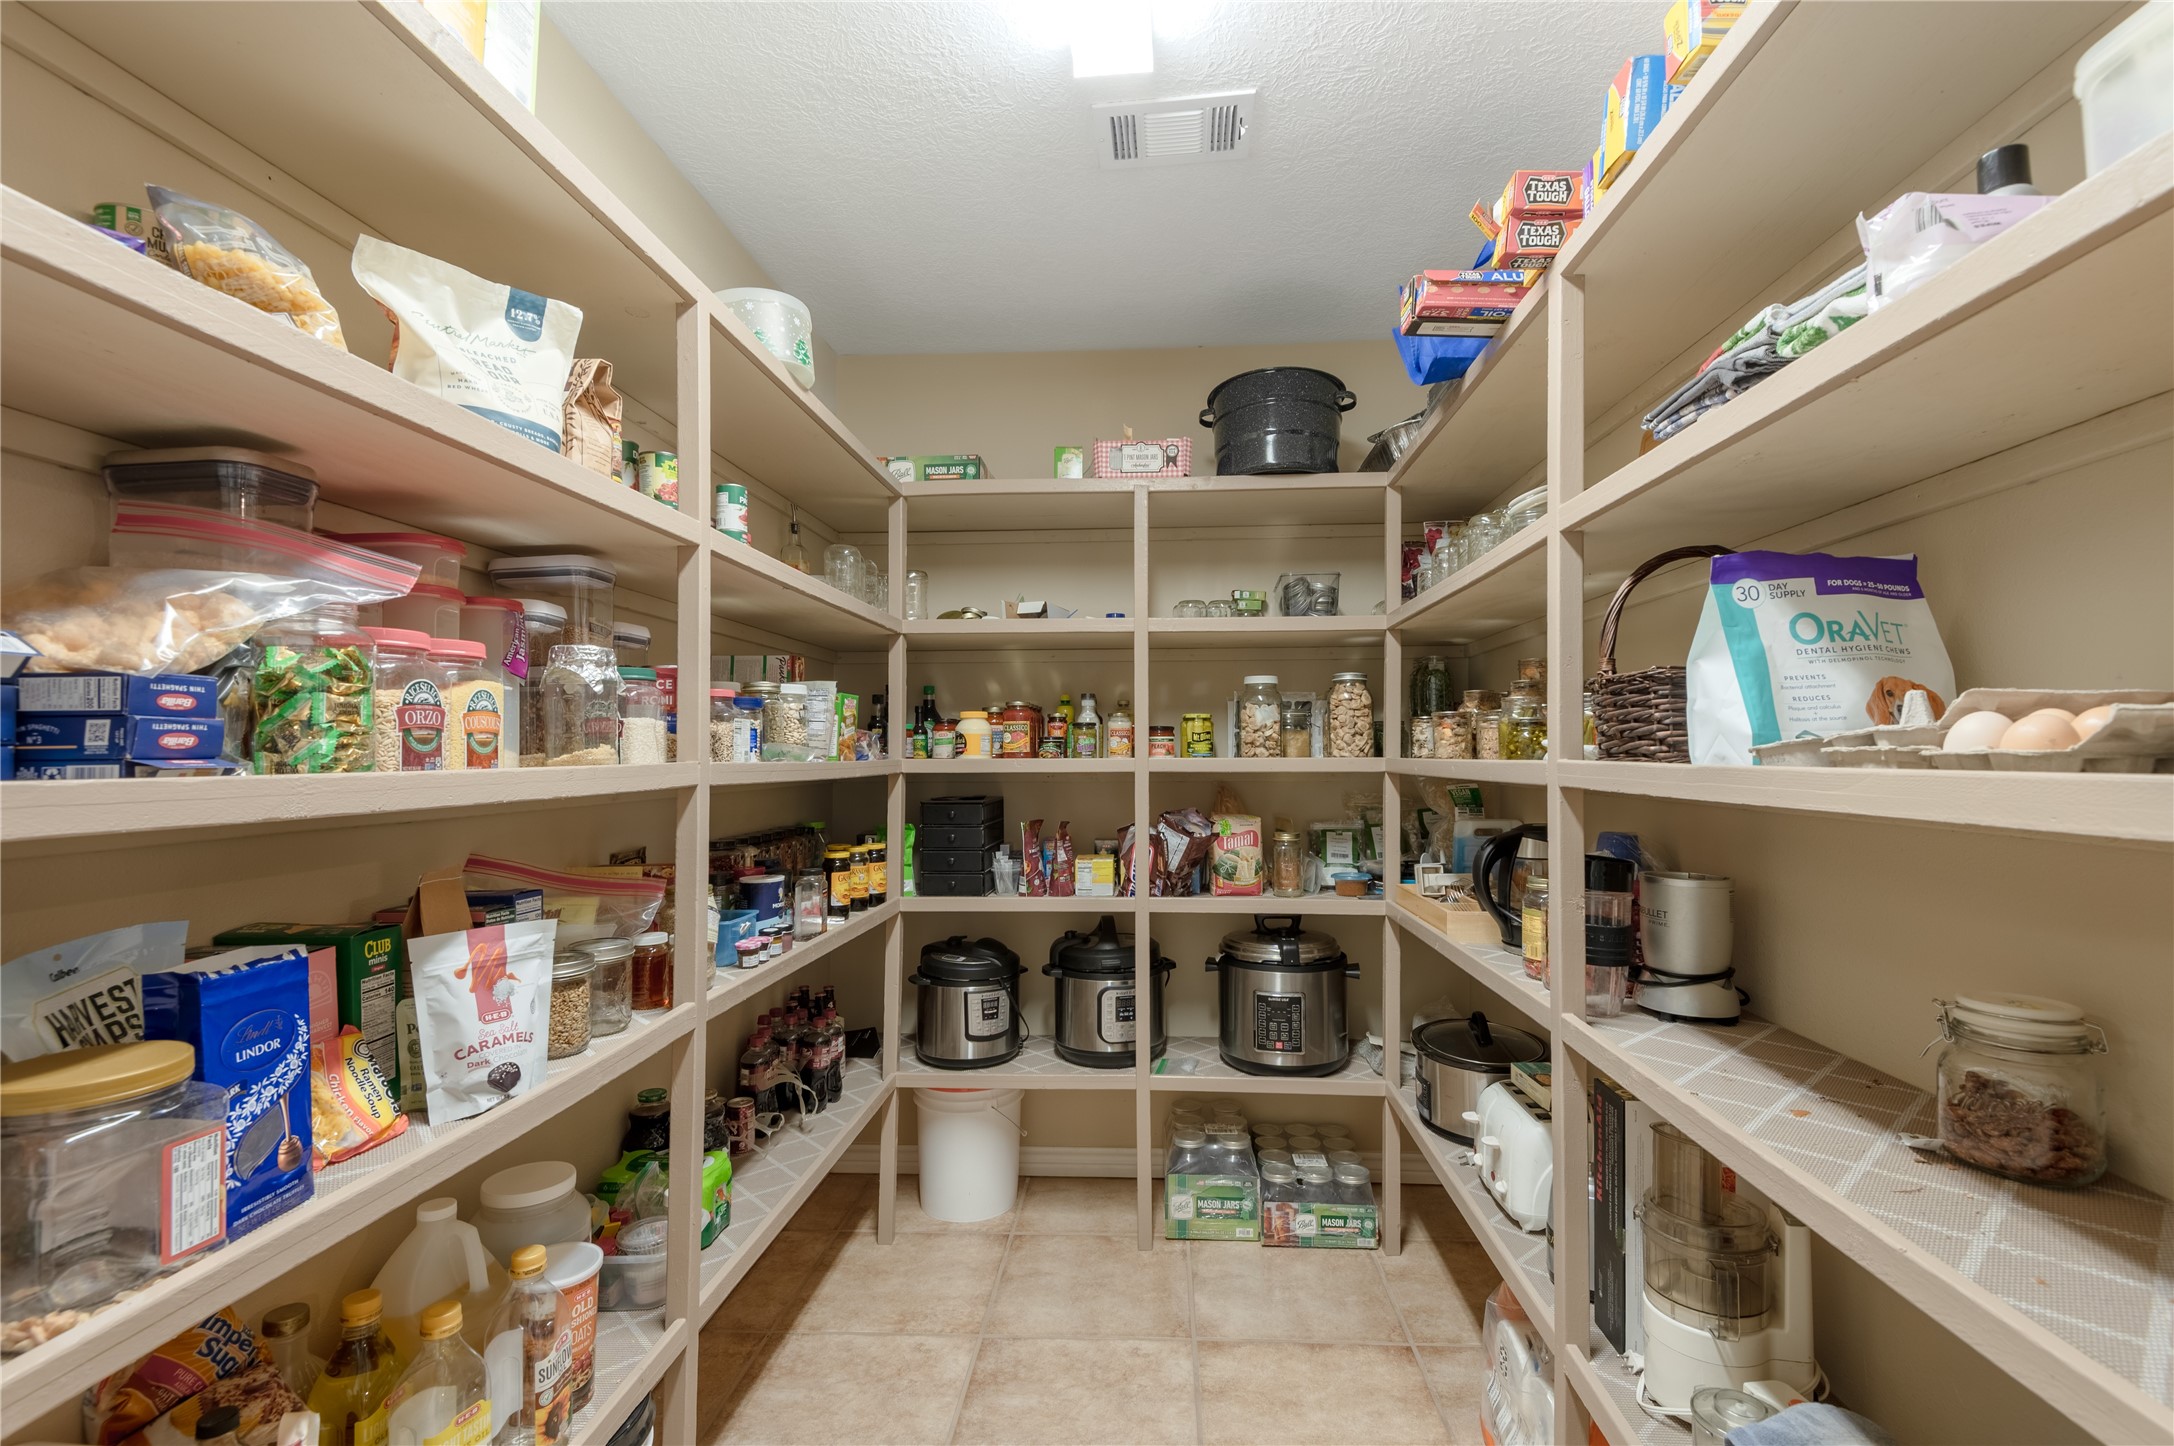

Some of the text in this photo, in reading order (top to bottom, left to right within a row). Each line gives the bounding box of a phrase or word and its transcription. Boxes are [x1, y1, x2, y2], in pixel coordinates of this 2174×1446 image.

[1529, 181, 1567, 192] TEXAS
[1527, 191, 1568, 202] TOUGH
[1522, 225, 1559, 236] TEXAS
[1520, 235, 1560, 246] TOUGH
[470, 333, 537, 354] Market
[925, 465, 964, 475] MASON JARS
[1768, 582, 1788, 592] DAY
[1844, 579, 1862, 587] DOGS
[1884, 583, 1910, 592] POUNDS
[1735, 585, 1760, 602] 30
[1769, 589, 1806, 600] SUPPLY
[503, 628, 519, 666] American
[1796, 645, 1911, 656] DENTAL HYGIENE CHEWS
[150, 683, 185, 693] SPAGHETTI
[656, 680, 673, 690] CE
[160, 695, 194, 709] Barilla
[1792, 694, 1832, 702] REDUCES
[404, 710, 441, 725] ORZO
[465, 715, 501, 731] COUSCOUS
[152, 723, 208, 731] THIN SPAGHETTI
[1003, 724, 1028, 732] CLASSICO
[161, 734, 196, 747] Barilla
[1223, 832, 1254, 850] Tamal
[364, 938, 392, 959] CLUB
[368, 954, 388, 966] minis
[361, 971, 395, 984] Nutrition Facts
[384, 986, 395, 994] 140
[362, 992, 382, 1002] Calories
[45, 977, 137, 1049] HARVEST
[236, 1018, 273, 1045] Lindt
[478, 1020, 519, 1041] Sea Salt
[235, 1038, 281, 1063] LINDOR
[453, 1031, 534, 1061] CARAMELS
[478, 1045, 513, 1059] COVERED
[466, 1058, 491, 1069] Dark
[345, 1057, 382, 1119] Noodle Soup
[359, 1068, 383, 1102] Ramen
[328, 1073, 375, 1137] Chicken Flavor
[275, 1179, 299, 1195] SMOOTH
[249, 1197, 283, 1219] CHOCOLATE
[1197, 1200, 1240, 1209] MASON JARS
[1296, 1219, 1314, 1230] Ball
[1321, 1218, 1362, 1228] MASON JARS
[571, 1296, 594, 1318] OLD
[571, 1321, 592, 1345] OATS
[173, 1368, 196, 1384] PURE
